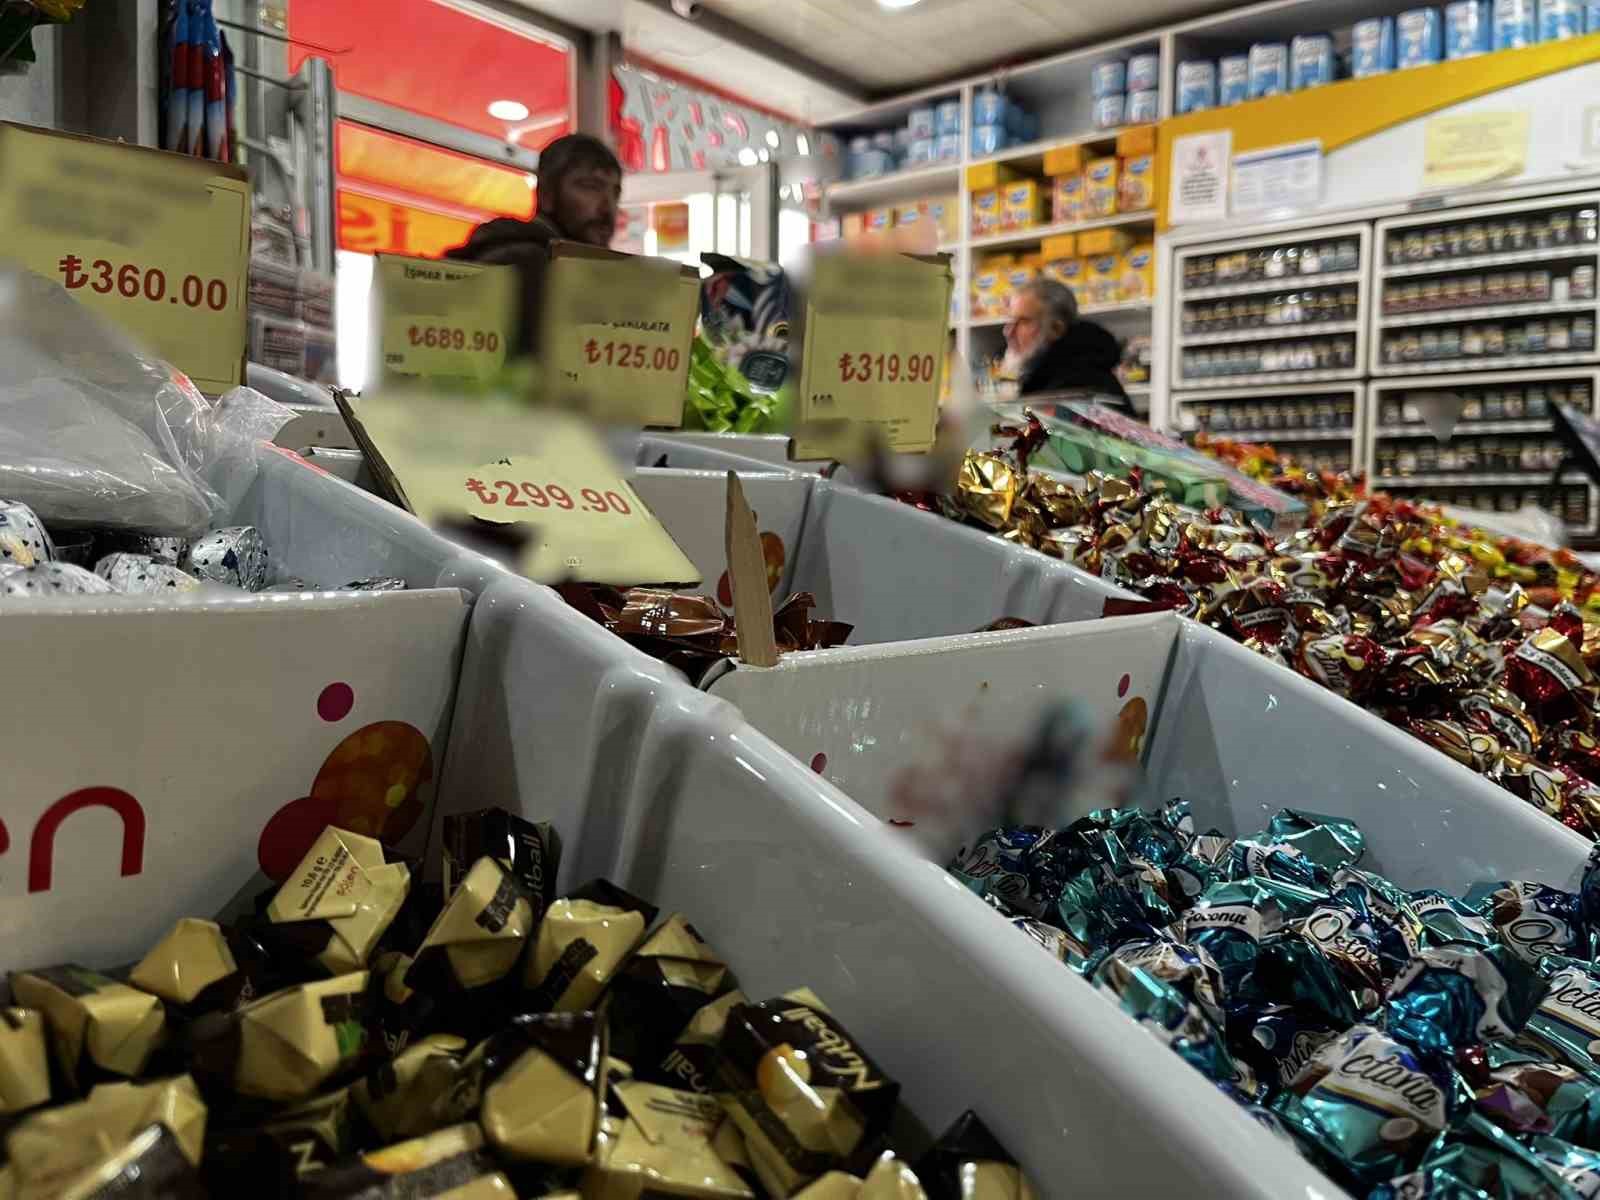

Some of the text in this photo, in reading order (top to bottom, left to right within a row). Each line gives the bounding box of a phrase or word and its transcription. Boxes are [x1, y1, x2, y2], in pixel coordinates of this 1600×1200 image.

[59, 254, 228, 311] ₺360.00
[408, 325, 499, 352] ₺689.90
[584, 338, 680, 371] ₺125.00
[839, 353, 935, 382] ₺319.90
[465, 478, 632, 515] ₺299.90
[781, 1007, 881, 1090] Nutball
